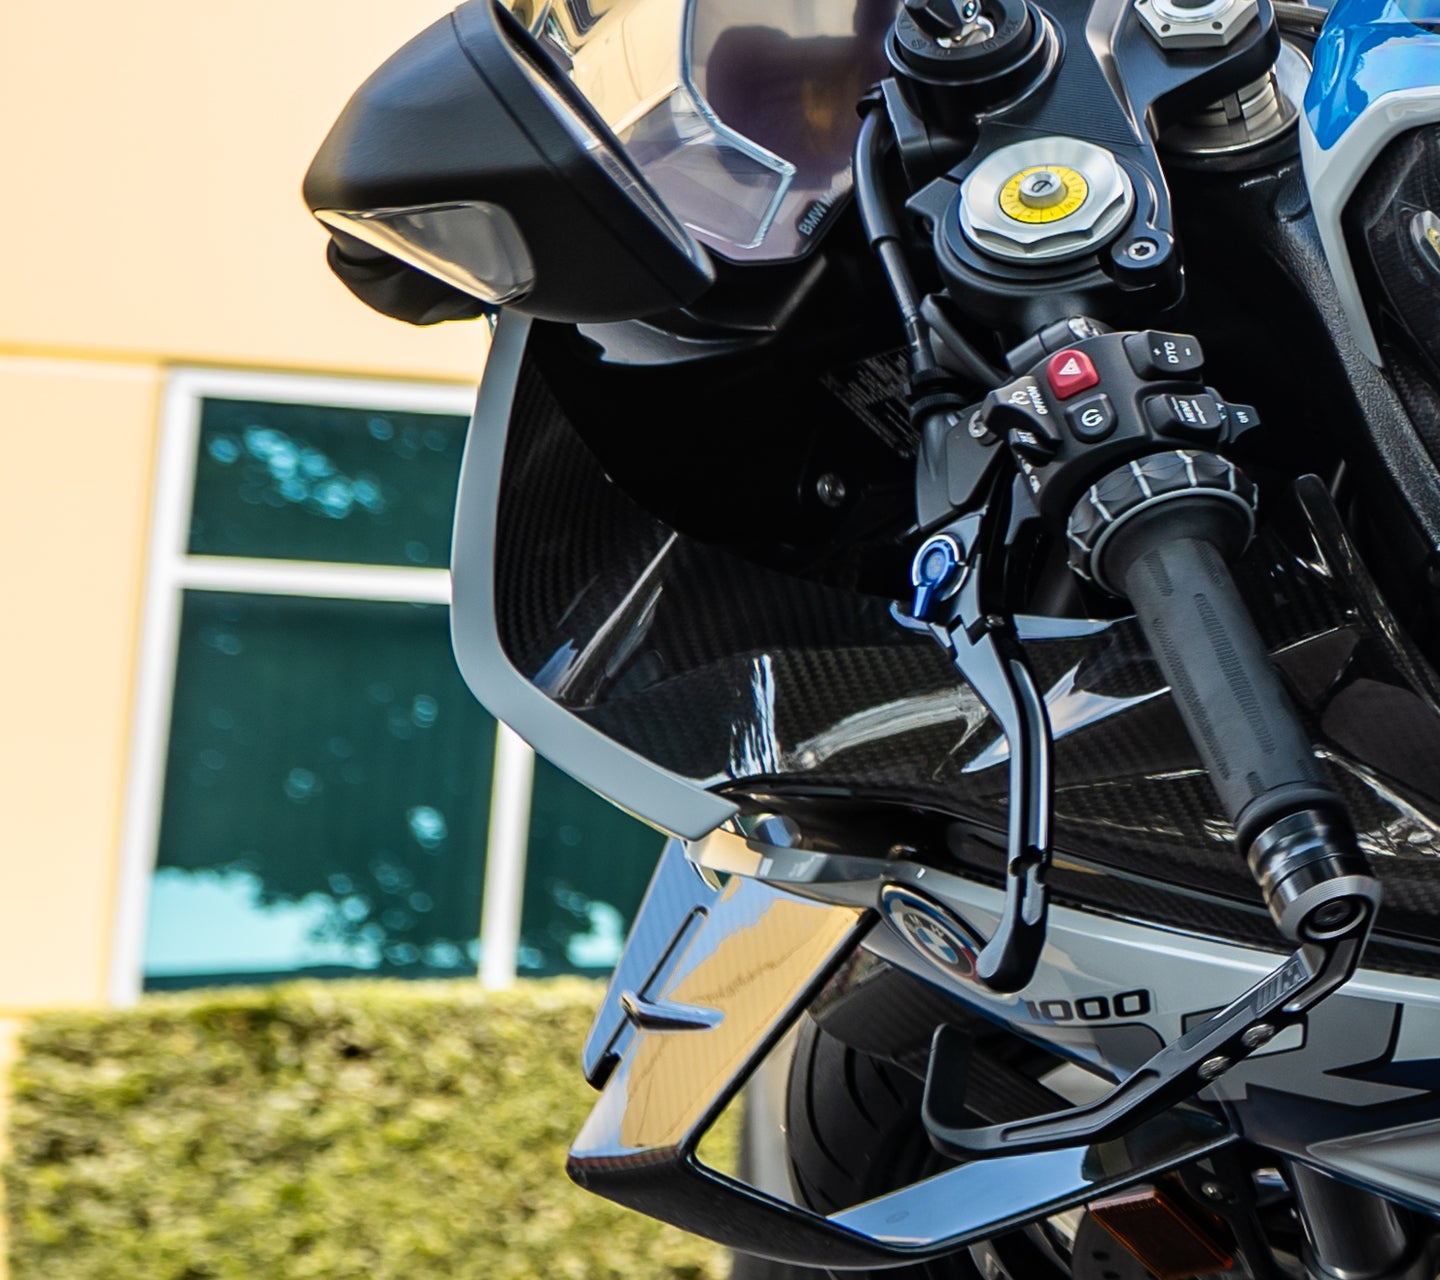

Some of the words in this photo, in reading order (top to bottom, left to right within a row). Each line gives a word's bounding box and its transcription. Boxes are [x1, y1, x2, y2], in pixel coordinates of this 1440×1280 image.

[798, 201, 827, 236] BMW
[1164, 341, 1179, 364] DTC
[1026, 988, 1151, 1021] 1000
